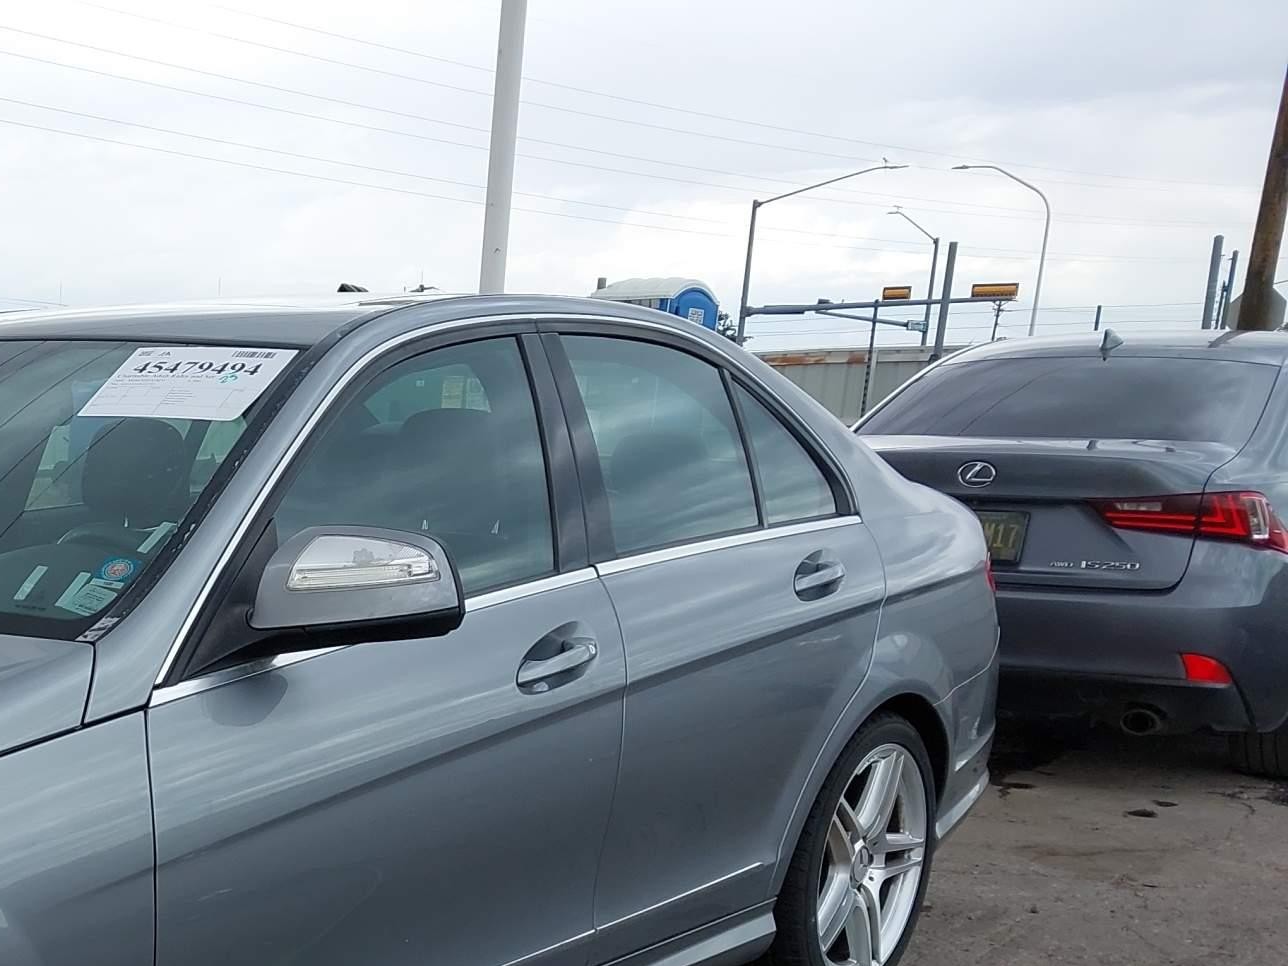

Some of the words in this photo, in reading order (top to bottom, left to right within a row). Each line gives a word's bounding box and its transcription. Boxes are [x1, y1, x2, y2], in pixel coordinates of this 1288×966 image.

[133, 361, 263, 375] 45479494
[1080, 560, 1101, 570] IS
[1102, 561, 1140, 570] 250
